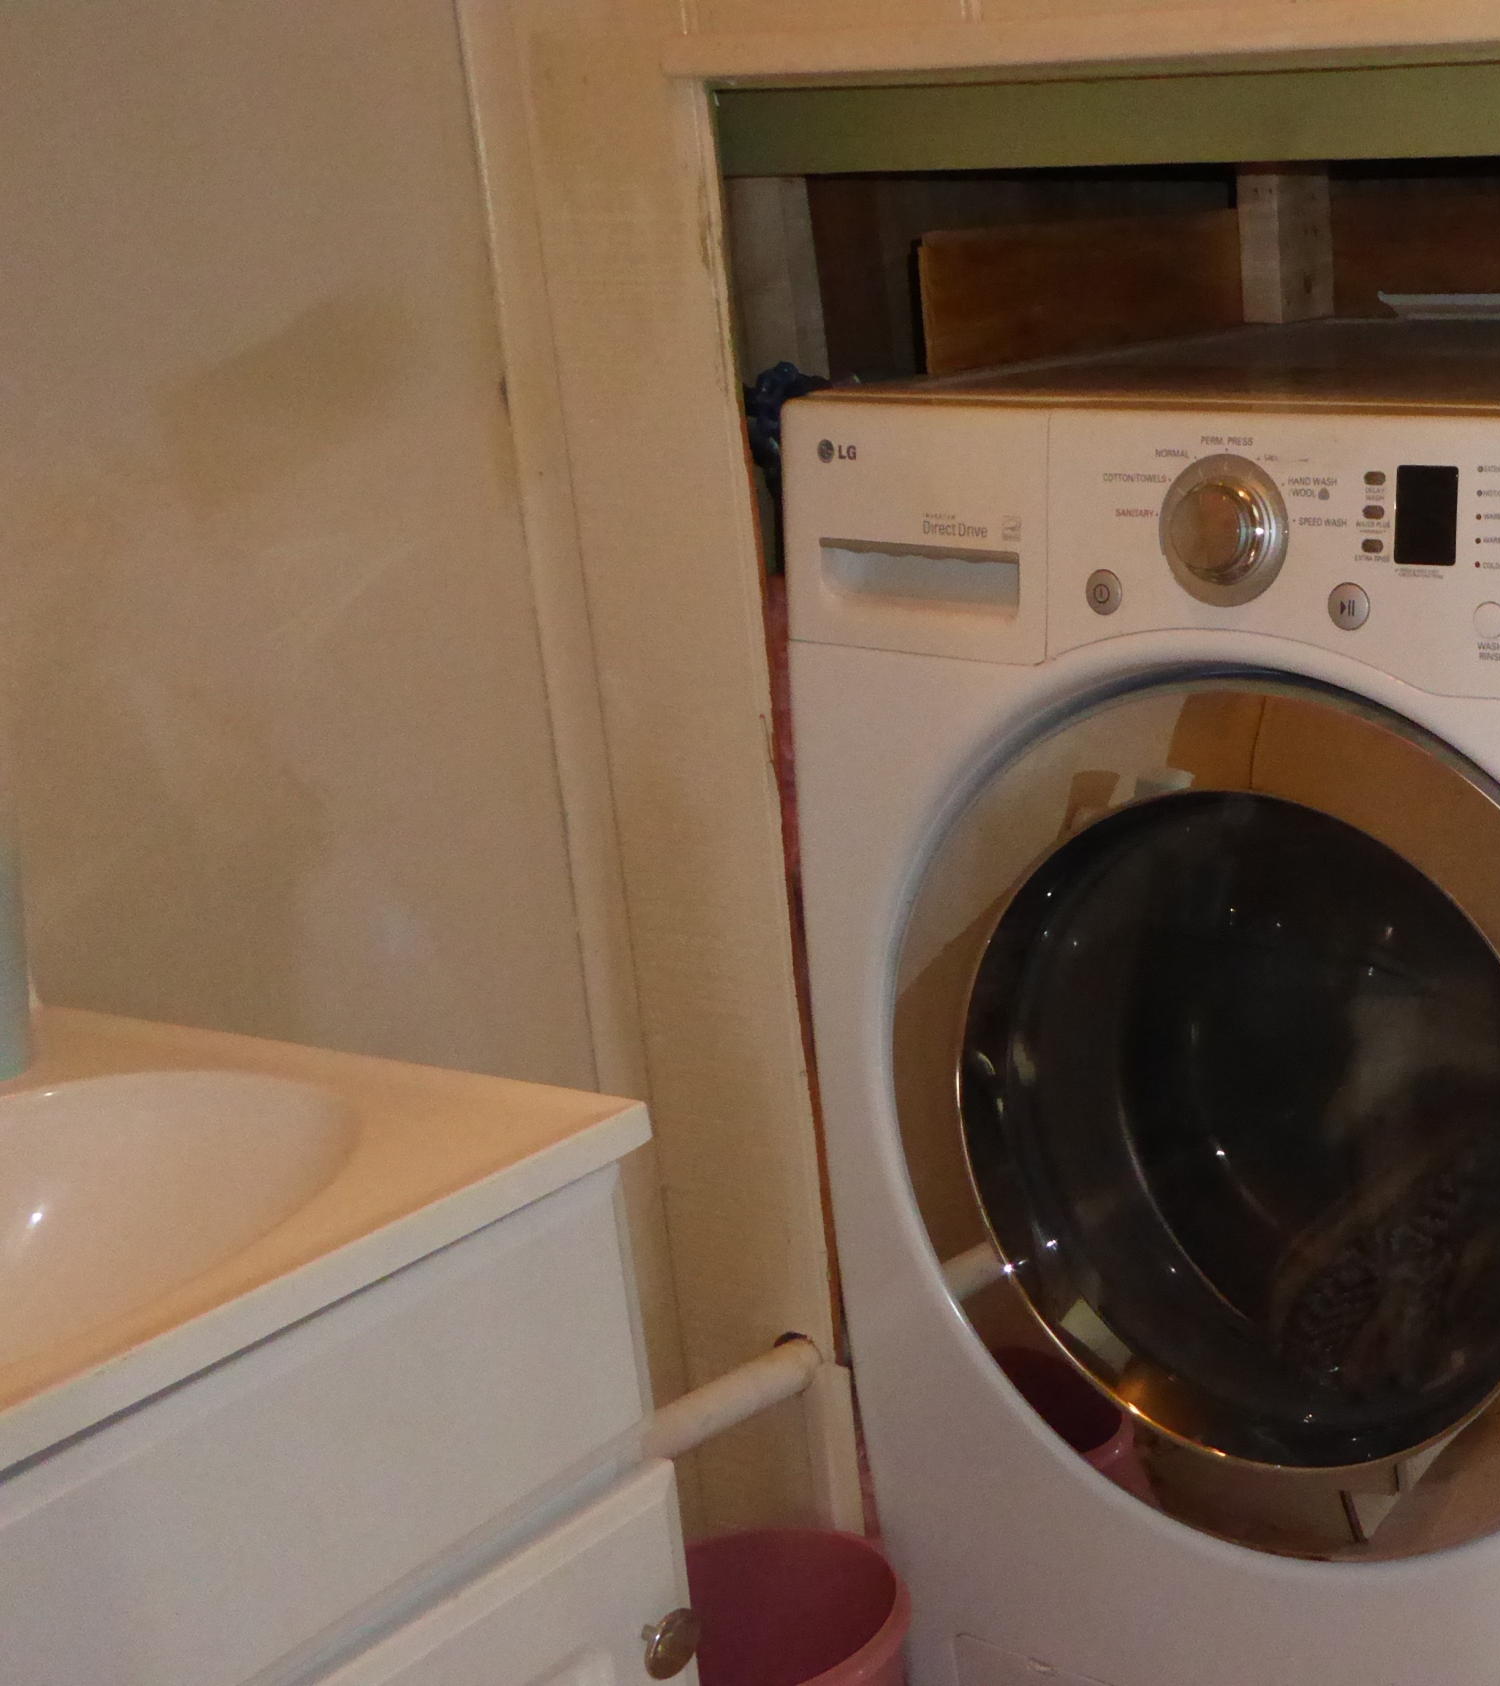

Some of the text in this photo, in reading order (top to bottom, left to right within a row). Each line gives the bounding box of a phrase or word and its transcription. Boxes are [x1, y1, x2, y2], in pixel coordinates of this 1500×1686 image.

[1227, 437, 1253, 446] PRESS
[838, 445, 857, 460] LG
[1313, 476, 1338, 486] WASH
[1298, 517, 1347, 528] SPEED WASH
[922, 520, 956, 537] Direct
[957, 522, 988, 538] Drive
